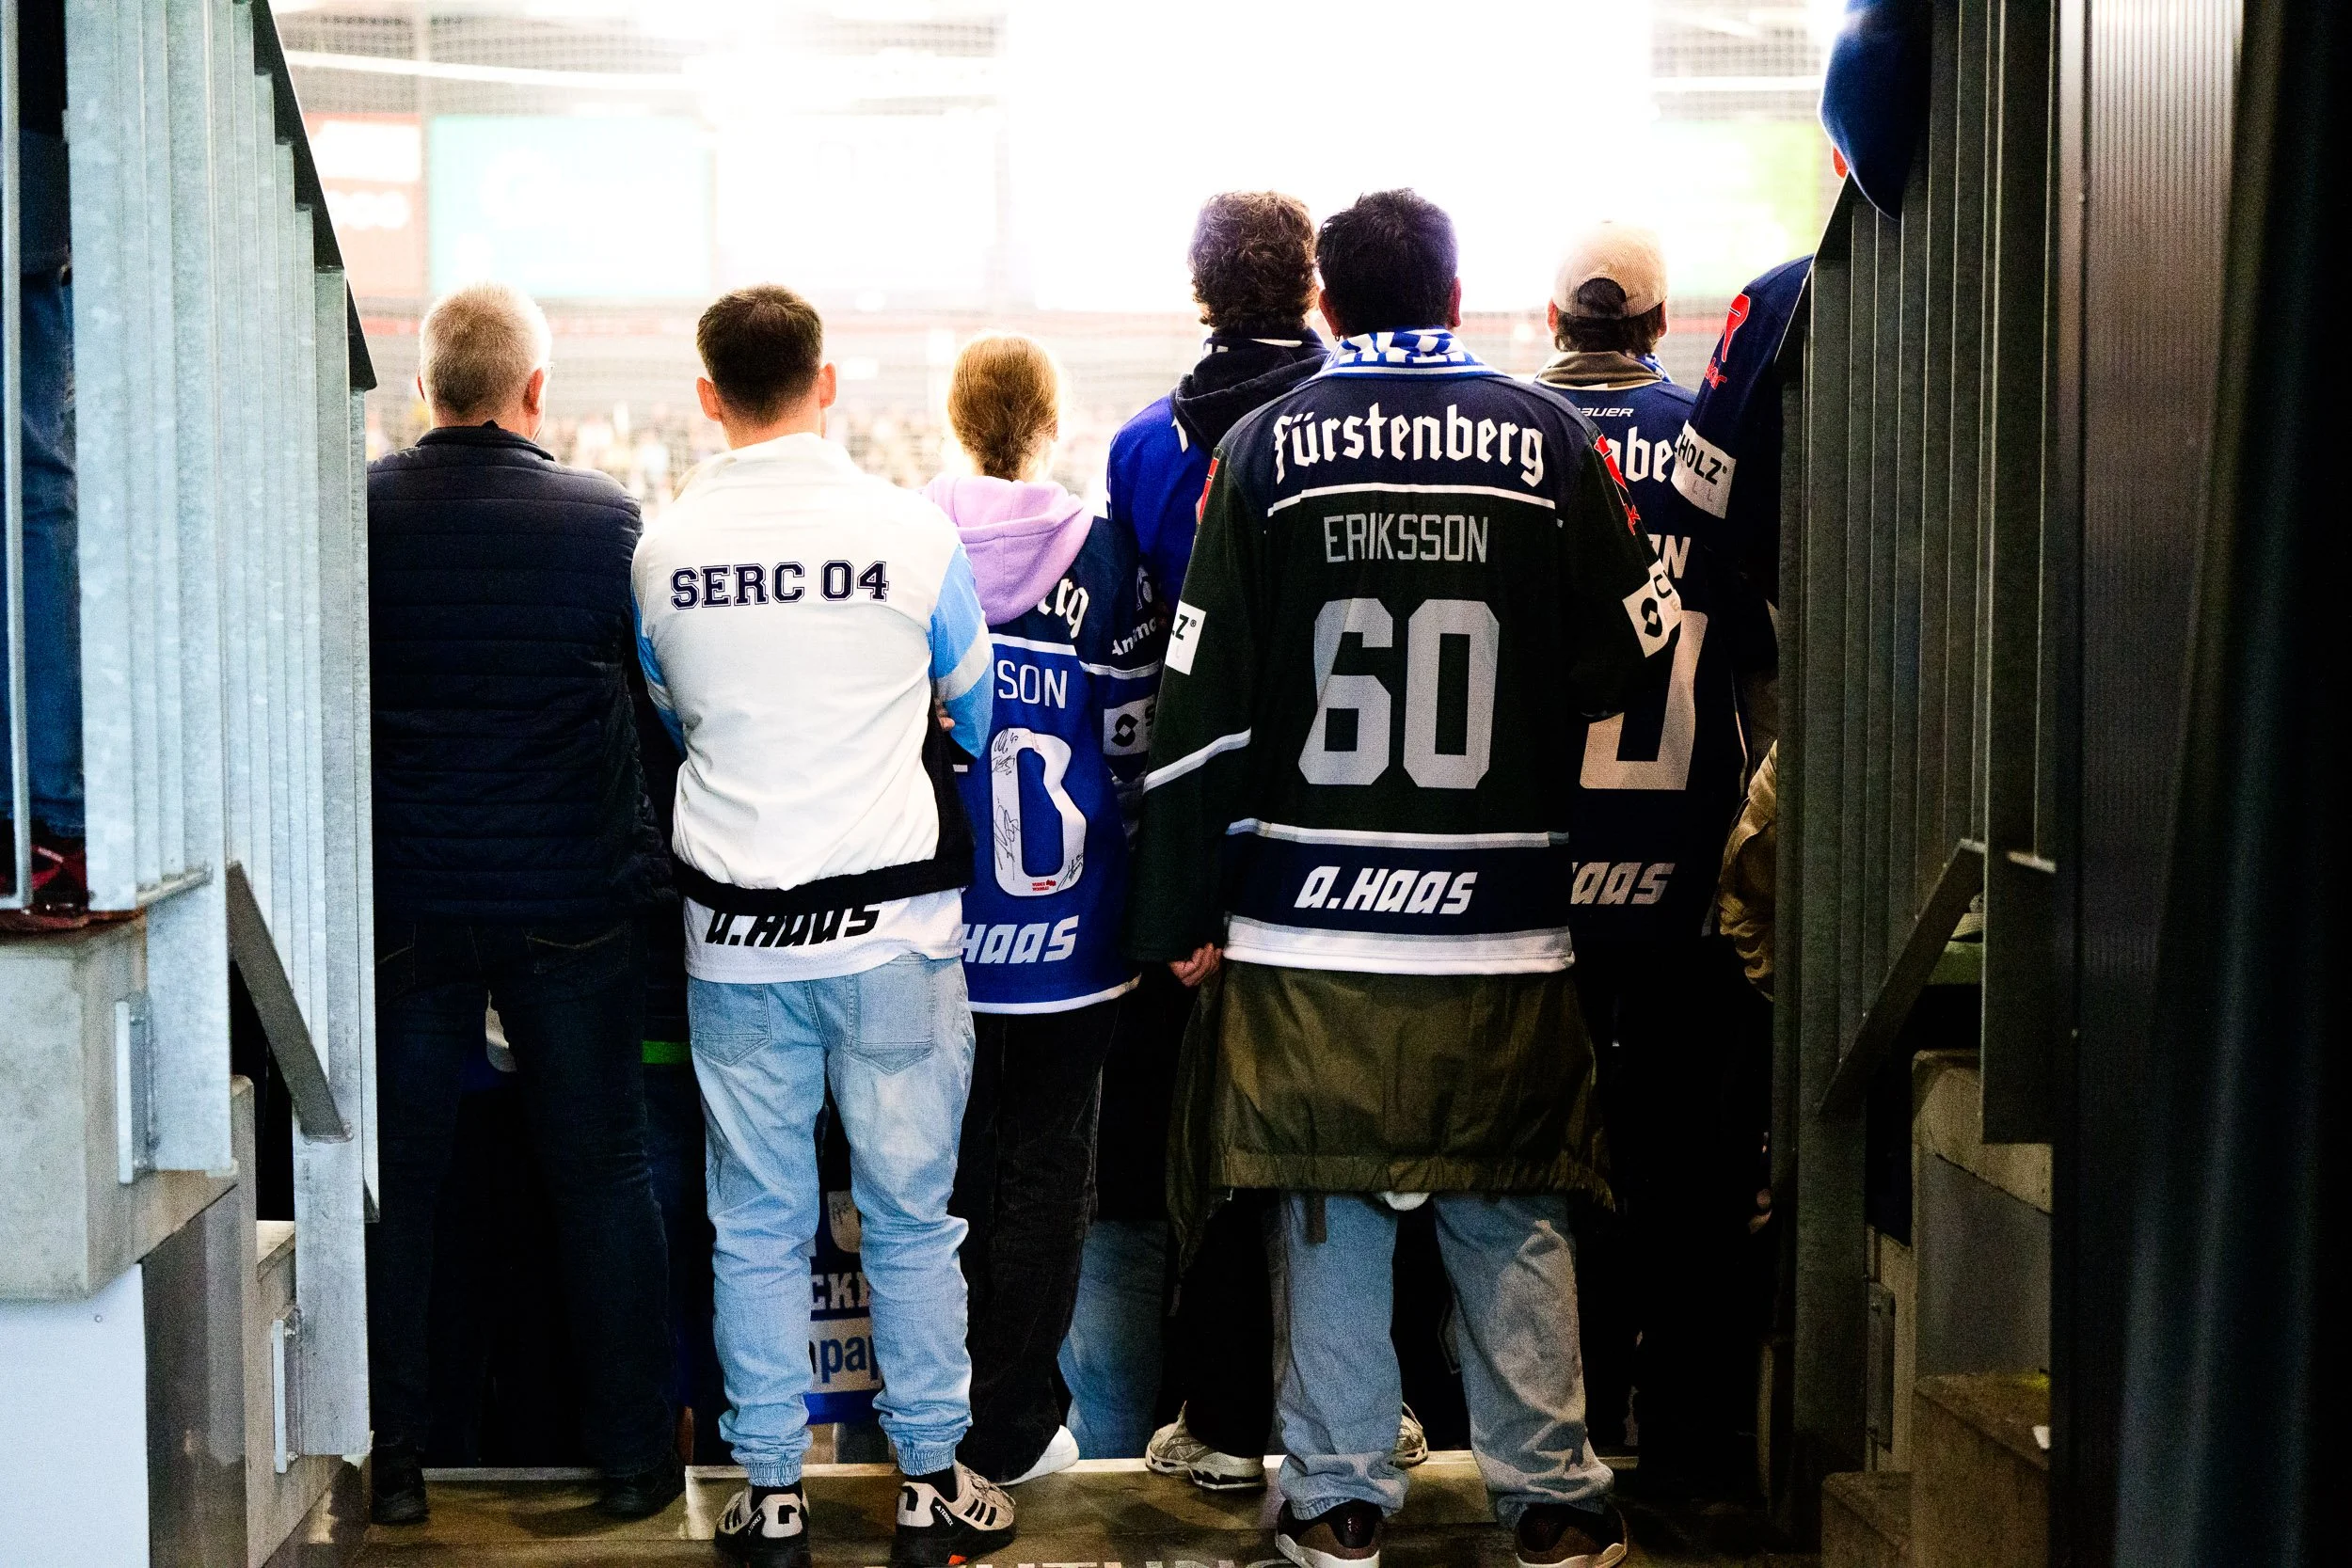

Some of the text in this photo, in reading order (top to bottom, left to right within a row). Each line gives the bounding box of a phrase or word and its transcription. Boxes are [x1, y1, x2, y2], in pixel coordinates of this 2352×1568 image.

[1324, 514, 1489, 563] ERIKSSON
[671, 560, 889, 610] SERC 04
[997, 659, 1068, 709] SON
[1298, 597, 1501, 789] 60
[1569, 862, 1677, 905] AAS
